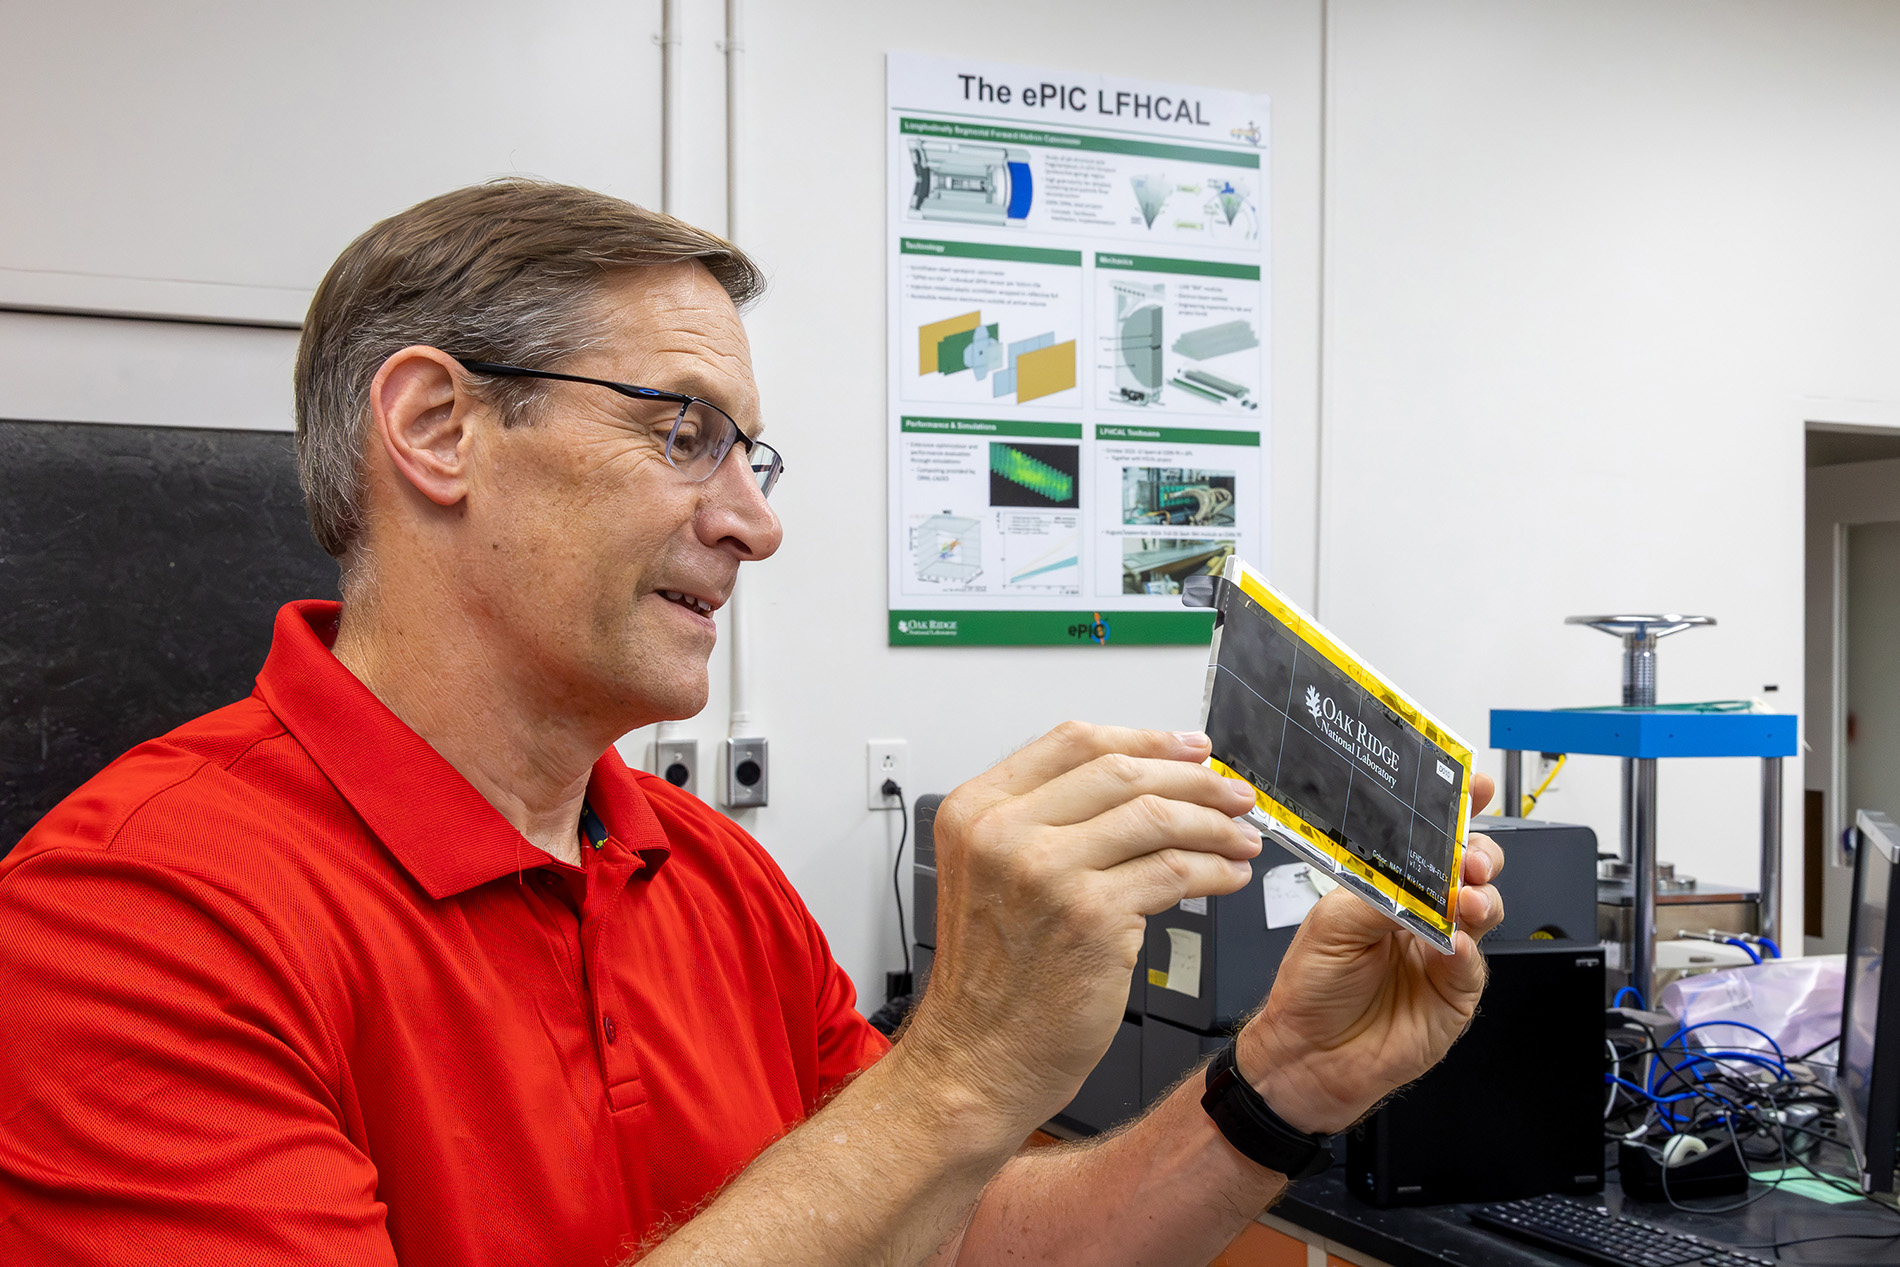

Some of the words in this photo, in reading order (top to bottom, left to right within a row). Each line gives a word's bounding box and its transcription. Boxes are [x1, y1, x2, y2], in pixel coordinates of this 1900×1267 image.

[958, 74, 1012, 104] The
[1022, 82, 1087, 112] ePIC
[1098, 89, 1211, 126] LFHCAL
[905, 240, 945, 253] Technology
[905, 419, 949, 429] Performance
[950, 420, 956, 429] &
[957, 421, 998, 431] Simulations
[1099, 427, 1126, 437] LFHCAL
[908, 620, 928, 630] OAK
[929, 620, 957, 630] RIDGE
[1322, 697, 1354, 737] OAK
[1355, 720, 1400, 773] RIDGE
[1320, 718, 1355, 755] National
[1356, 746, 1398, 789] Laboratory
